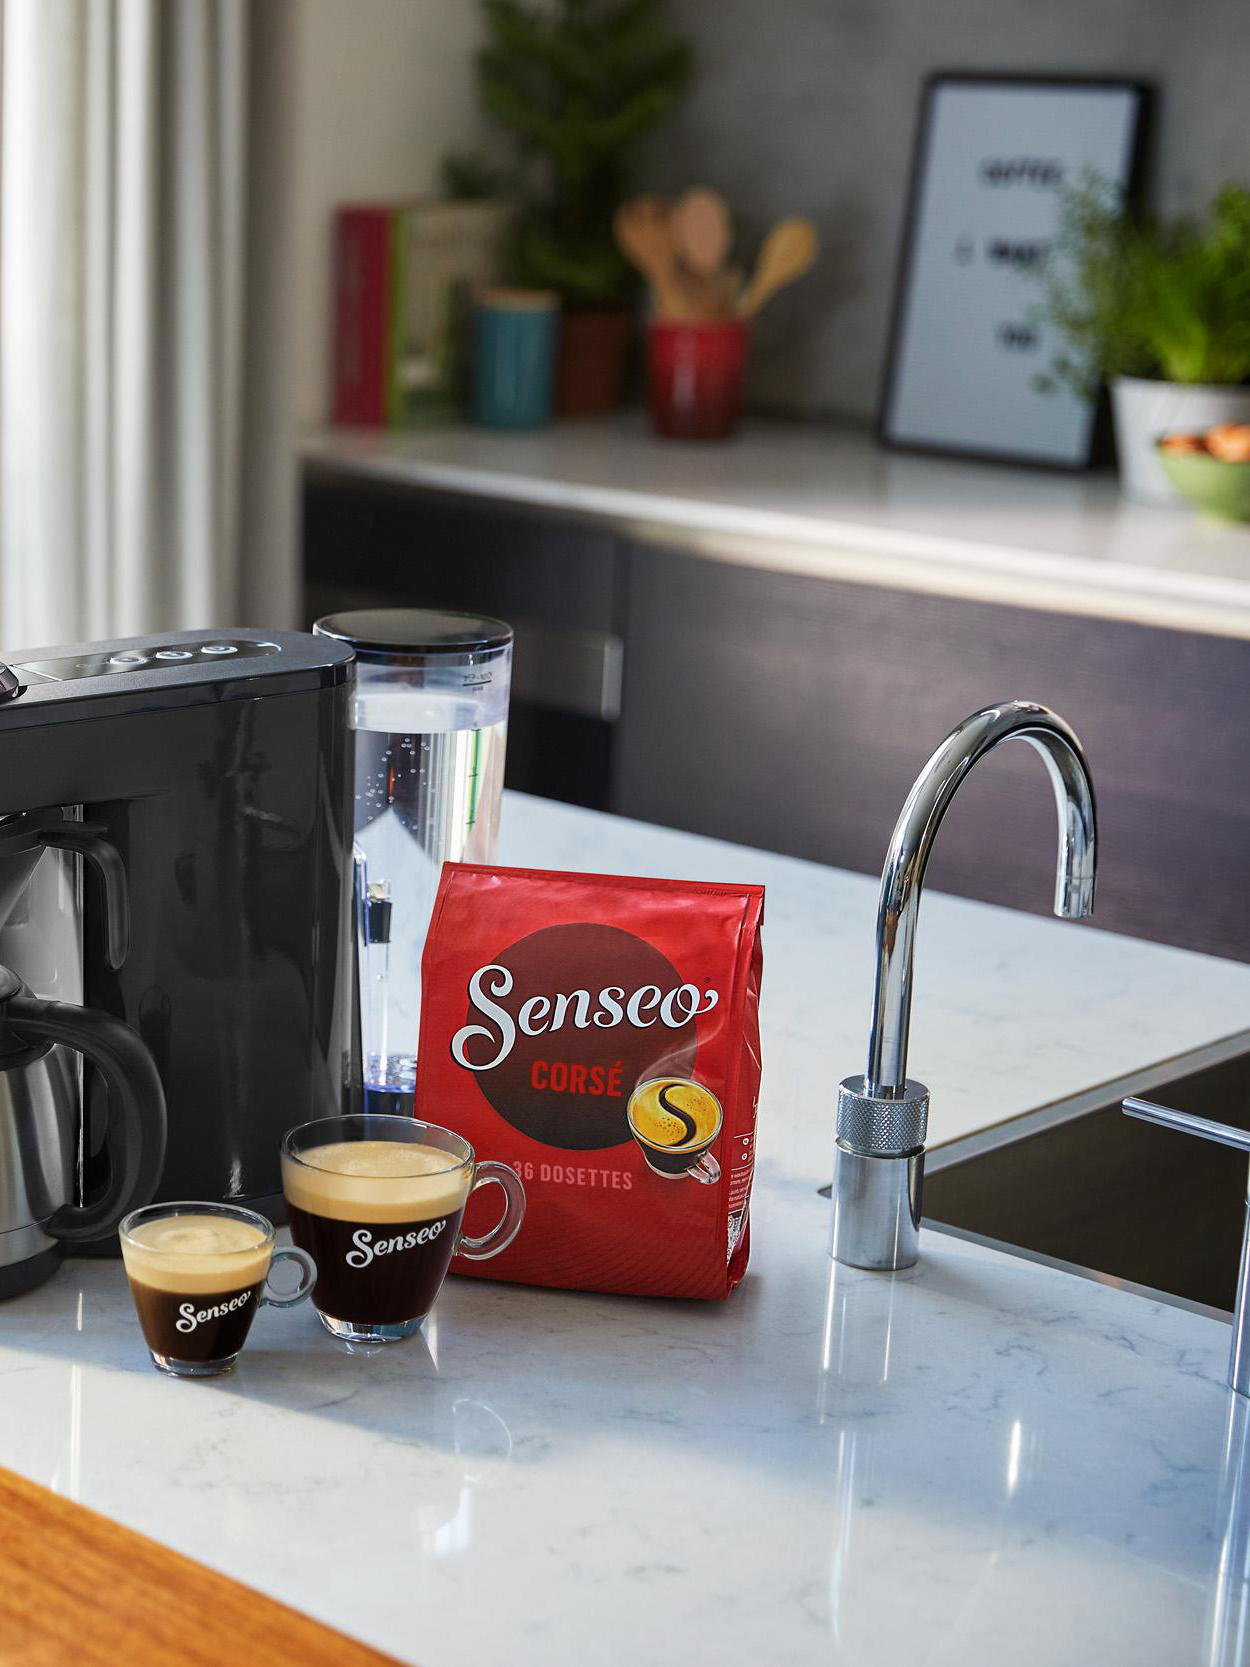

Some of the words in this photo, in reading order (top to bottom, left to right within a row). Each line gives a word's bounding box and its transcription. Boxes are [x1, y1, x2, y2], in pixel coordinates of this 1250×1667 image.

[450, 963, 720, 1072] Senseo
[530, 1060, 623, 1098] CORSÉ
[513, 1160, 535, 1181] 36
[540, 1163, 633, 1190] DOSETTES
[345, 1219, 447, 1269] Senseo
[175, 1290, 252, 1333] Senseo
